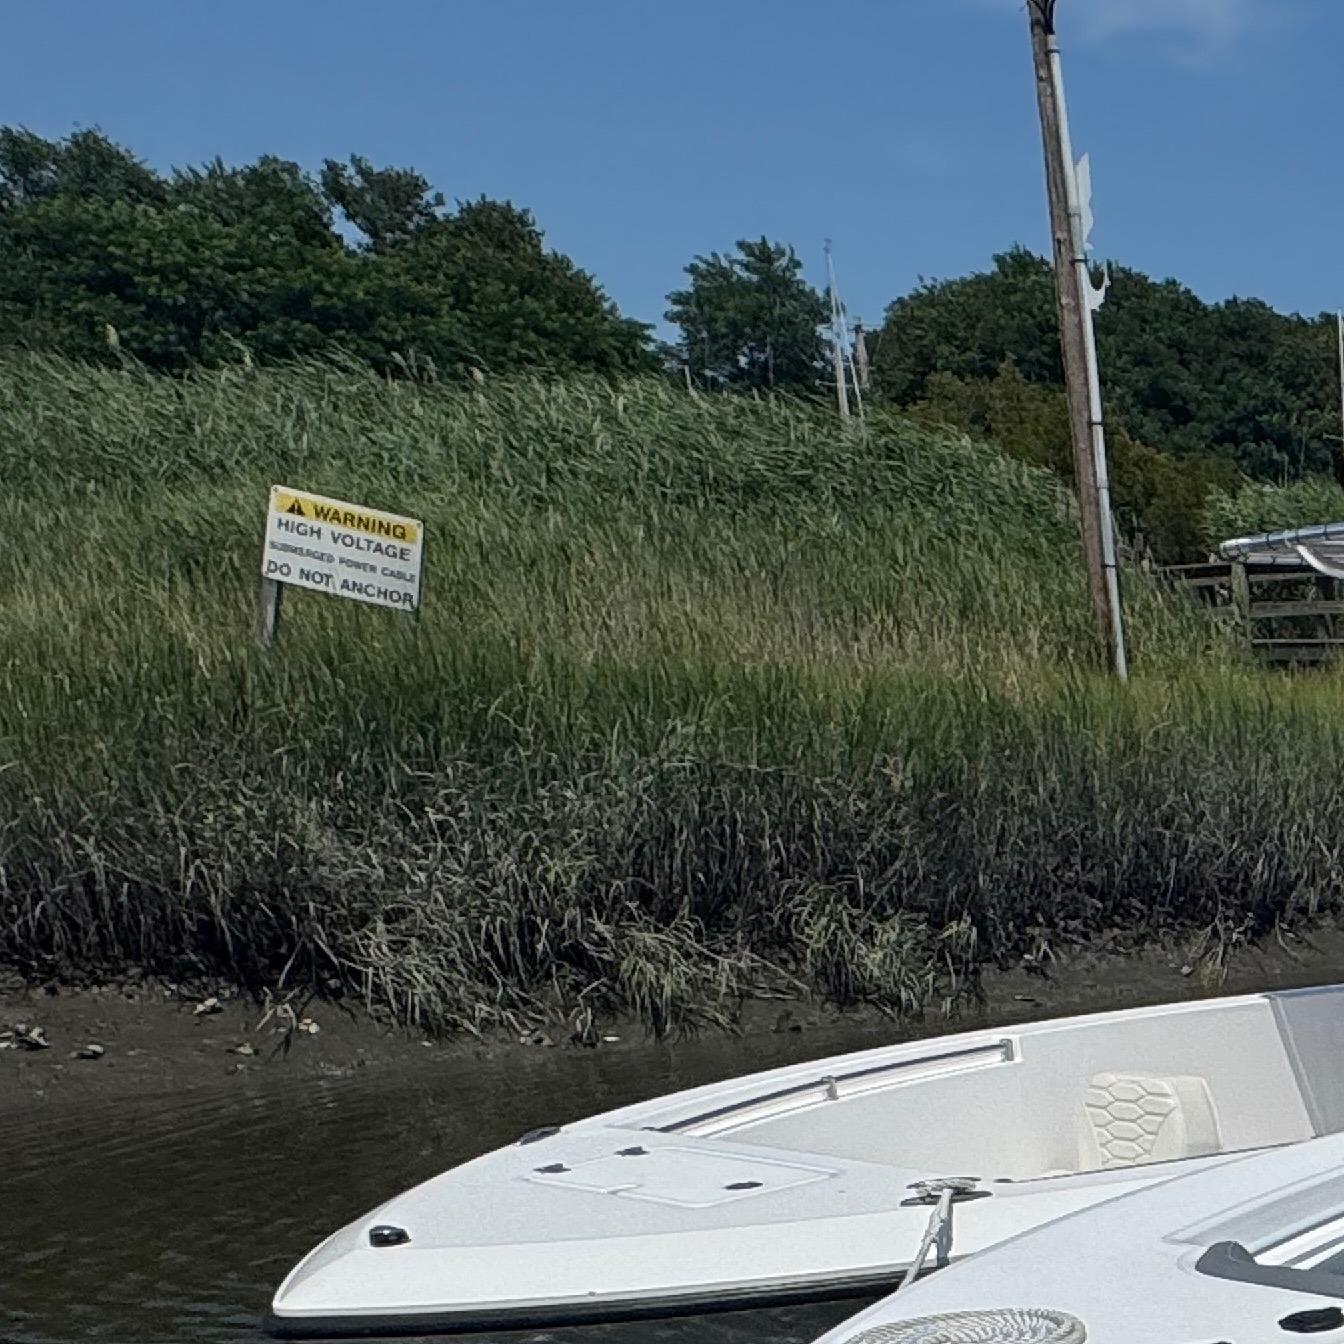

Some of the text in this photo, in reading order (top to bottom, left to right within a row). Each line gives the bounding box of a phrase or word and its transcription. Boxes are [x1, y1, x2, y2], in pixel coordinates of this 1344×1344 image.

[277, 518, 411, 561] HIGH VOLTAGE
[313, 504, 406, 540] WARNING
[267, 560, 415, 608] DO NOT ANCHOR
[339, 557, 377, 574] POWER
[381, 567, 416, 583] CABLE
